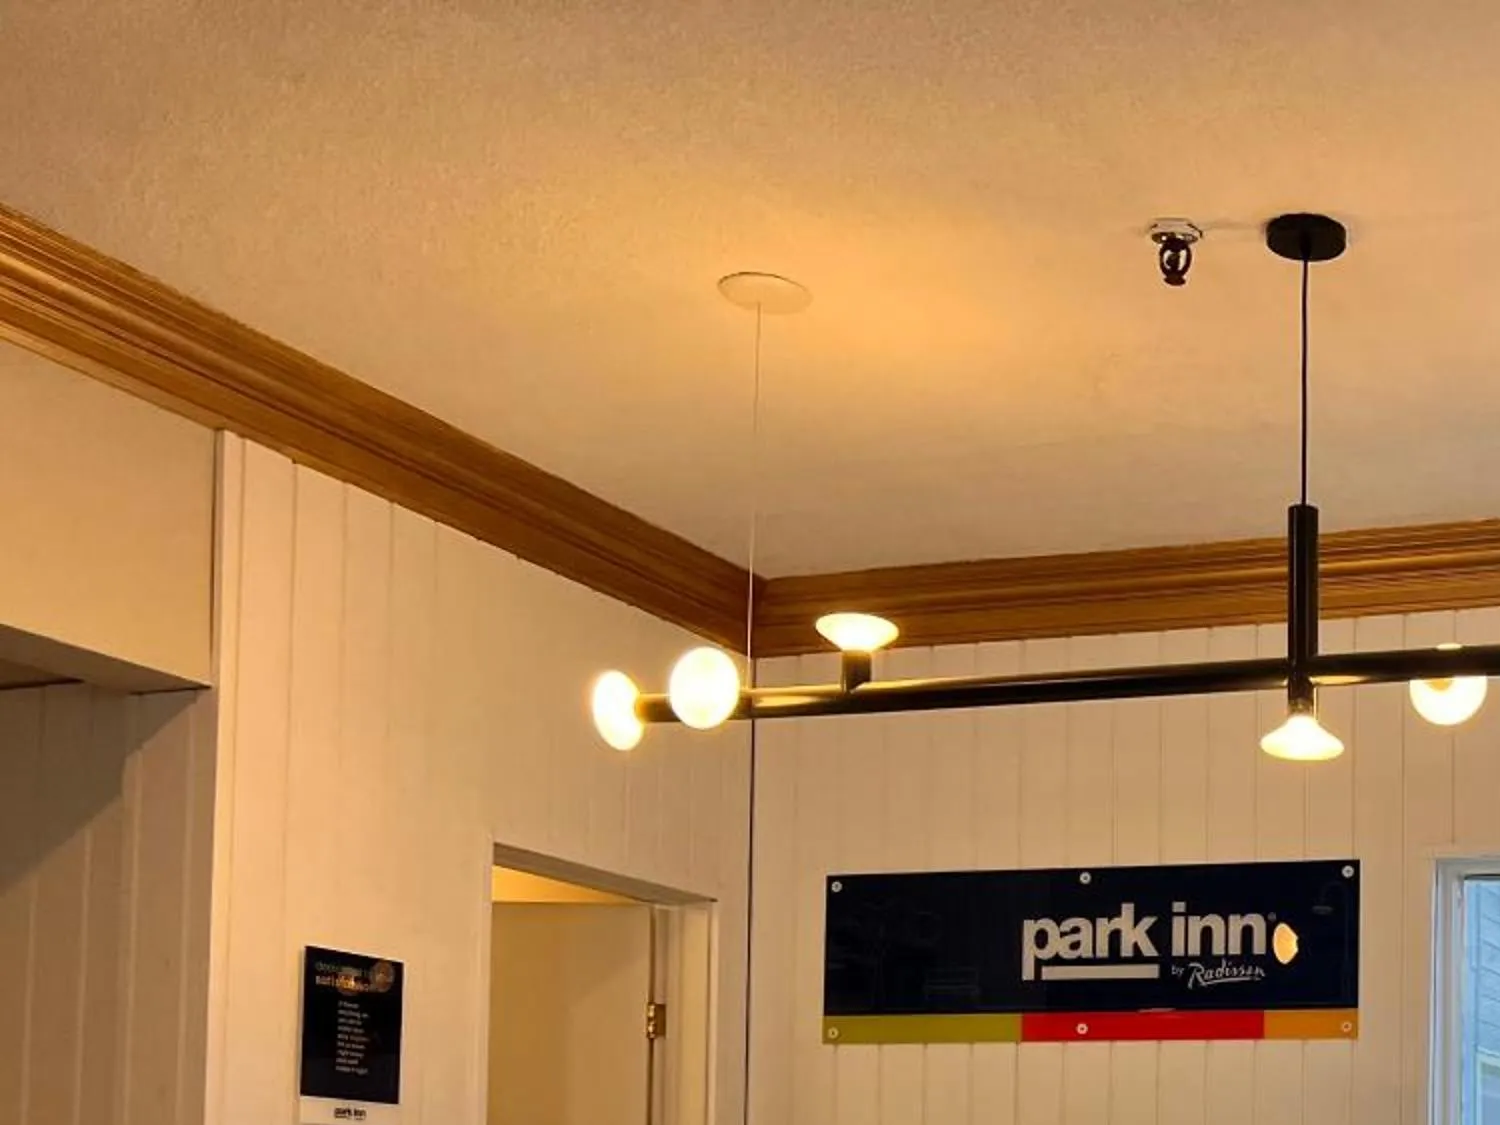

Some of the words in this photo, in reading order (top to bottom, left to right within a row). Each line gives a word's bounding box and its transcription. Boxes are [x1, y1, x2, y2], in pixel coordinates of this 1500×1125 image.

[1022, 903, 1159, 980] park
[1172, 901, 1266, 956] inn
[1171, 965, 1184, 978] by
[1187, 957, 1266, 989] Radisson
